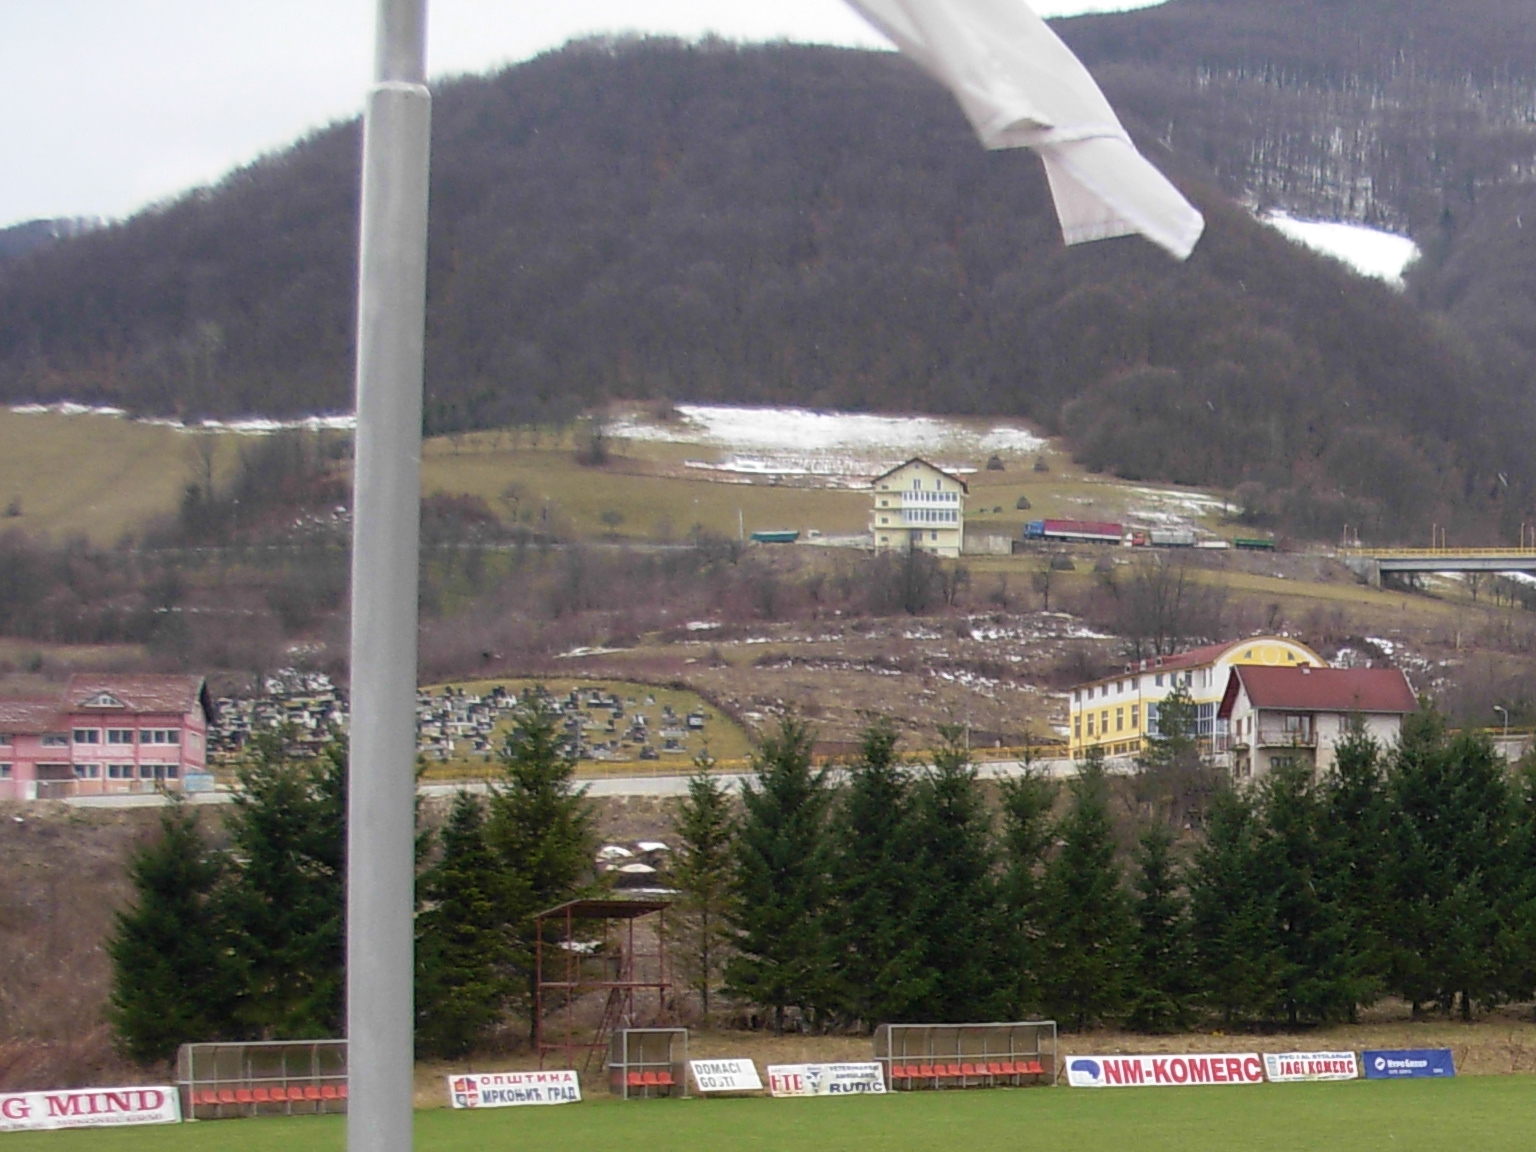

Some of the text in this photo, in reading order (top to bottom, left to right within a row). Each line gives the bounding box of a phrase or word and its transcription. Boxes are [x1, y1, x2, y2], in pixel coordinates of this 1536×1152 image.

[480, 1073, 573, 1086] ОПШТИНА
[1102, 1057, 1264, 1084] NM-KOMERC
[45, 1089, 166, 1117] MIND
[547, 1086, 577, 1102] ГРАД
